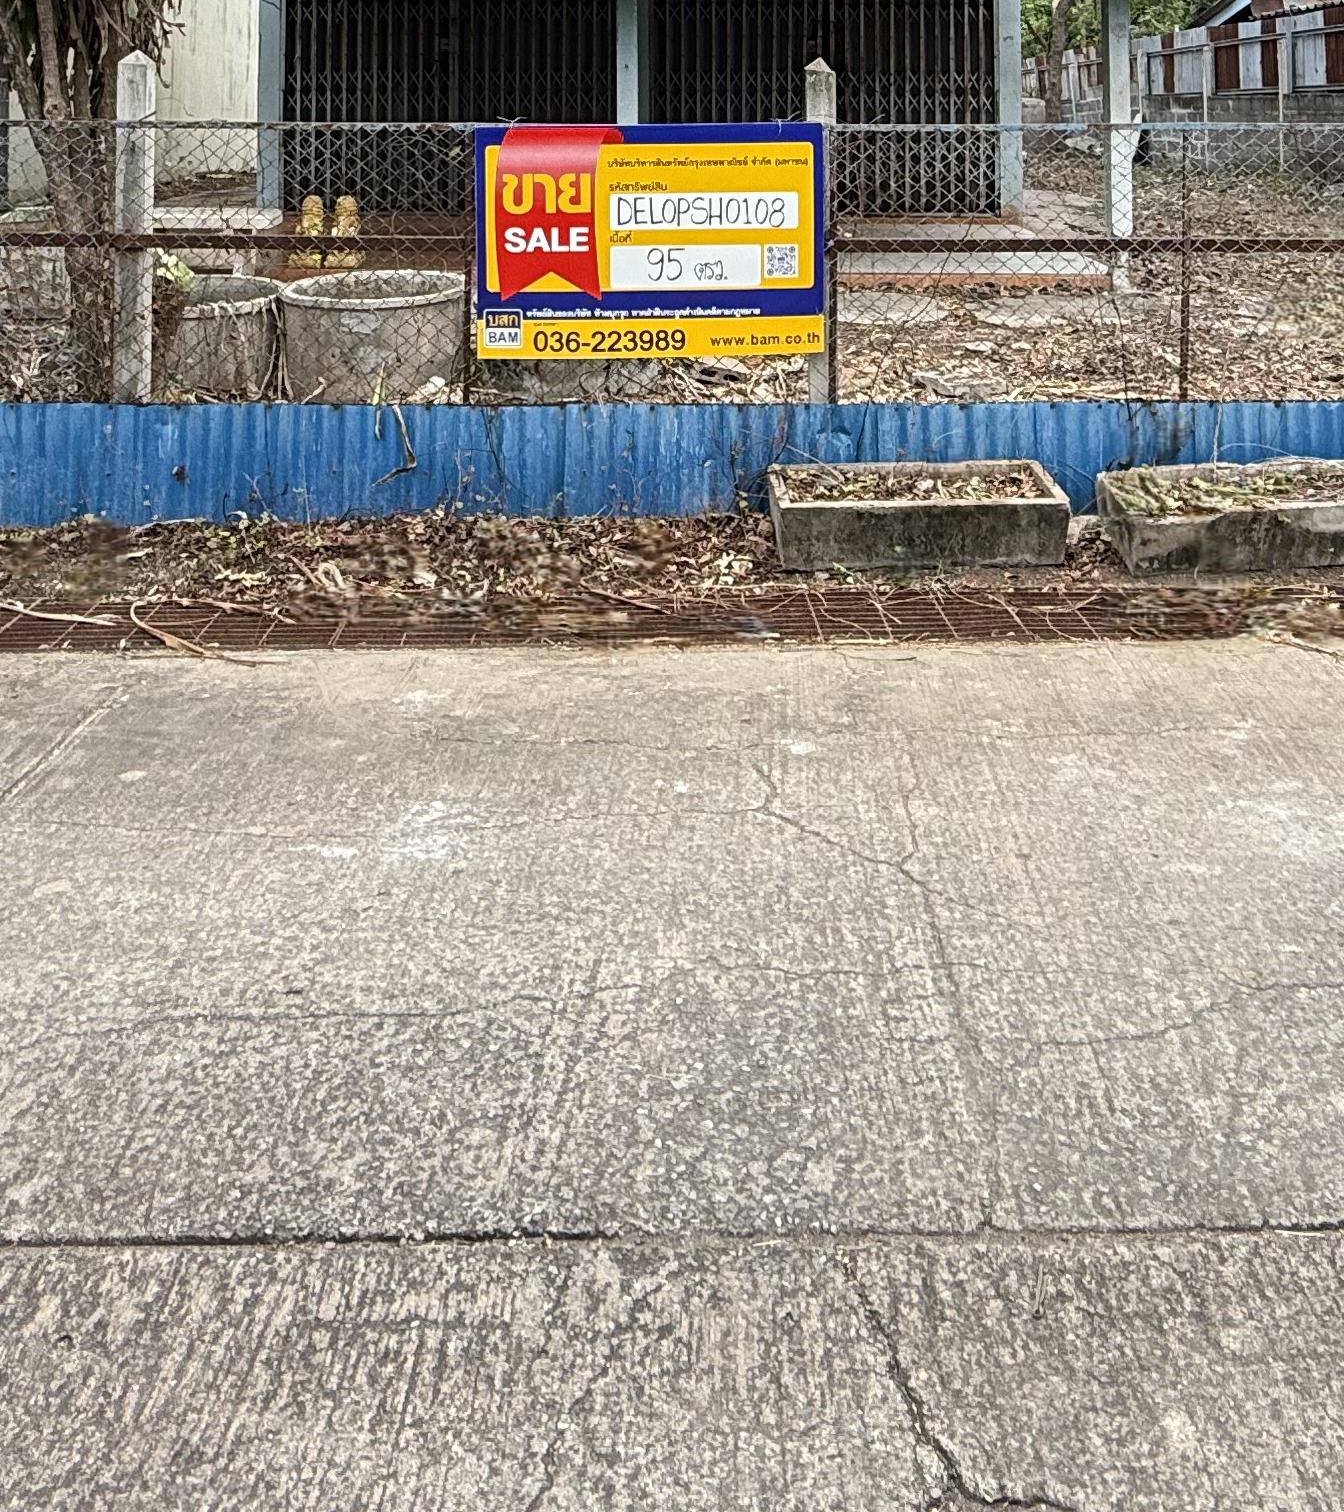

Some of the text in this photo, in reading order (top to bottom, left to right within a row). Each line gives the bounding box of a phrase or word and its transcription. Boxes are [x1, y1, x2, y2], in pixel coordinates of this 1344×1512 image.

[502, 173, 592, 215] ขาย
[504, 226, 590, 254] SALE
[647, 247, 686, 282] 95
[487, 314, 518, 327] บสก
[488, 331, 518, 343] BAM
[533, 329, 821, 353] 036-223989 www.bam.co.th
